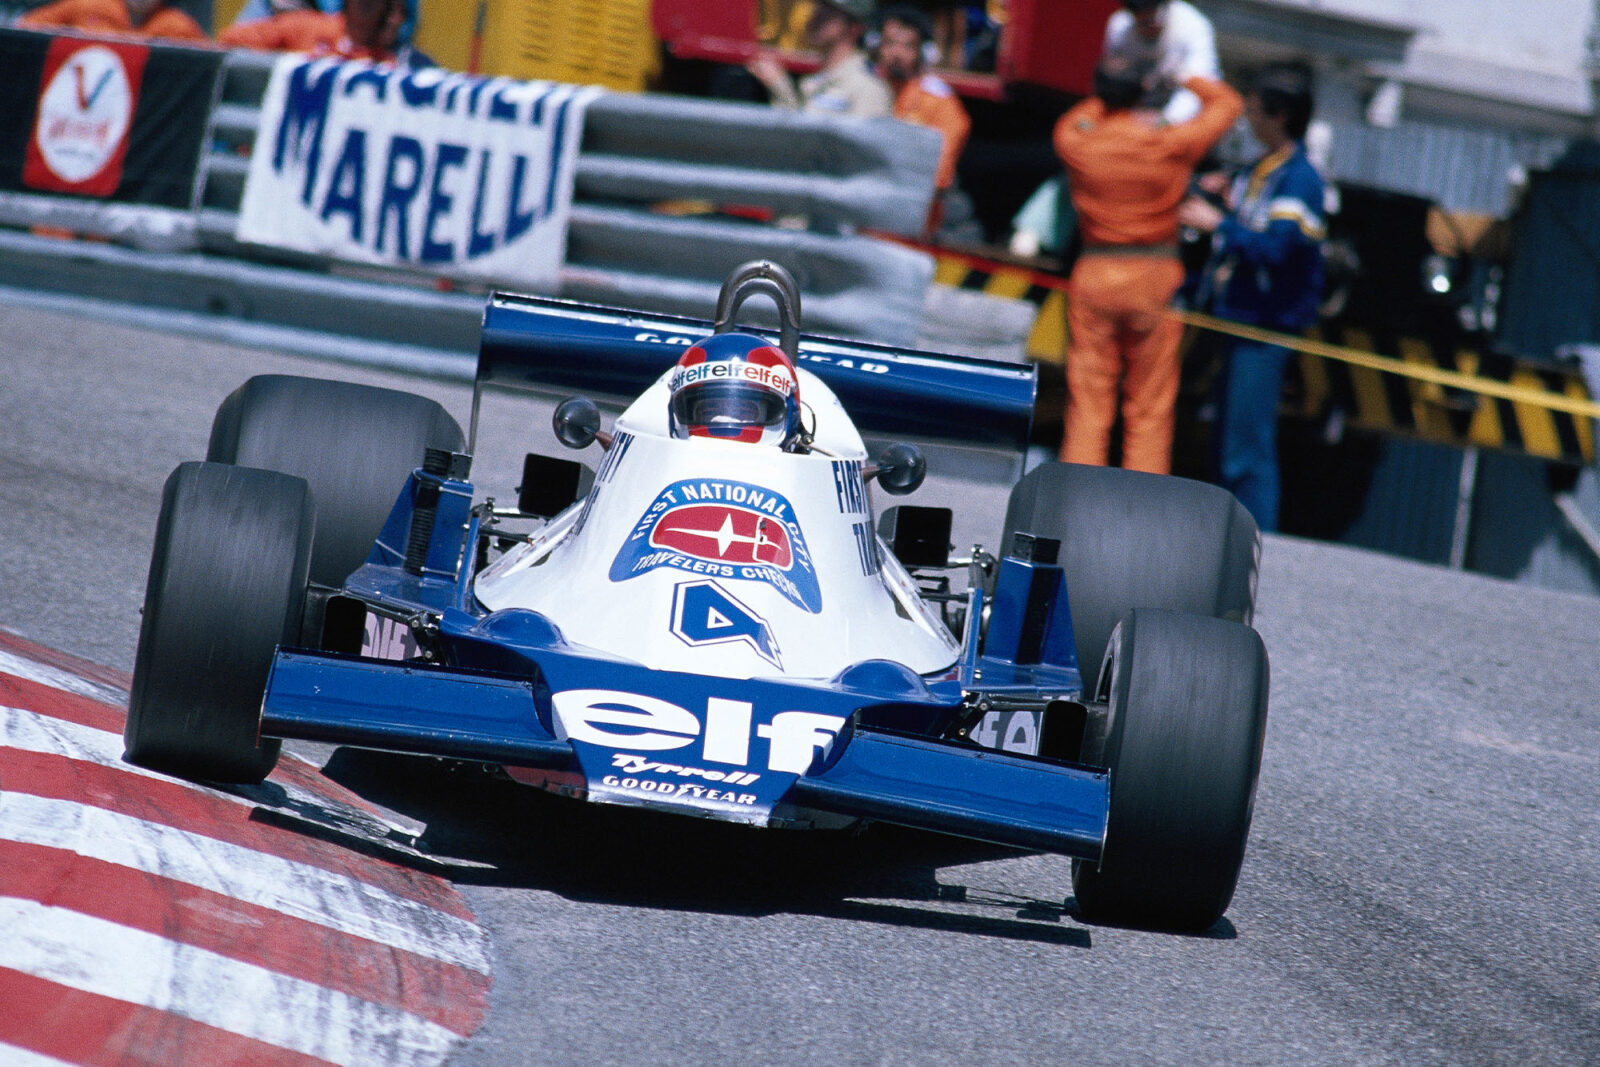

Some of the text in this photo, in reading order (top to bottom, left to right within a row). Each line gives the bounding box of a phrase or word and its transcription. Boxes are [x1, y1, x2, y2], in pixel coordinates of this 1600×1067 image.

[272, 63, 572, 264] MARELLI
[631, 490, 678, 541] FIRST
[681, 483, 788, 519] NATIONAL
[786, 522, 812, 574] CITY
[632, 551, 734, 577] TRAVELERS
[669, 579, 785, 672] 4
[552, 689, 846, 775] elf
[611, 753, 761, 786] Tyrrell
[602, 775, 757, 805] GOODYEAR
